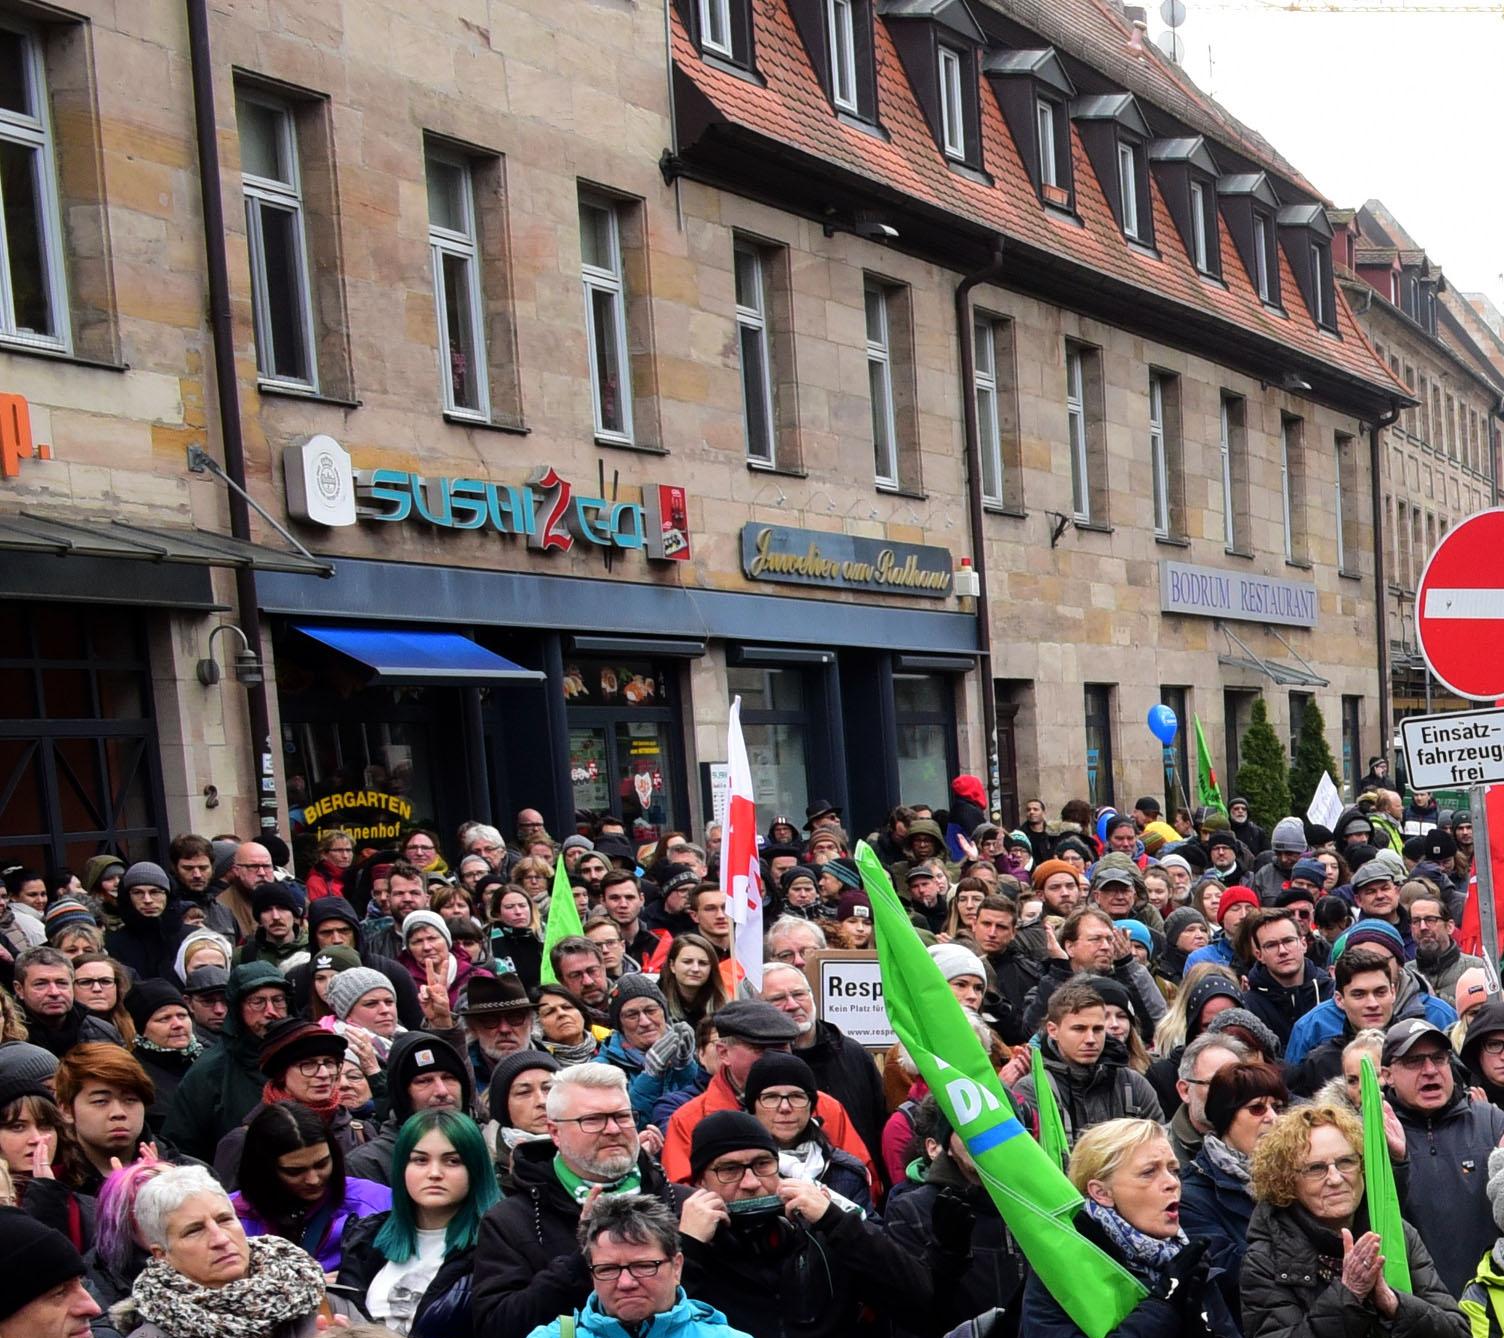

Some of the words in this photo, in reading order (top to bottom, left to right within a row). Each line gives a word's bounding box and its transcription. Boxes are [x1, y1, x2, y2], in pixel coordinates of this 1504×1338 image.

[751, 528, 840, 579] Juwelier
[843, 560, 874, 581] am
[875, 549, 950, 590] Rathaus
[1171, 570, 1231, 609] BODRUM
[1240, 580, 1315, 620] RESTAURANT
[1421, 722, 1502, 744] Einsatz-
[1451, 763, 1484, 782] frei
[304, 791, 413, 825] BIERGARTEN
[829, 976, 883, 1001] Resp
[829, 1004, 848, 1012] Kein
[850, 1004, 870, 1012] Platz
